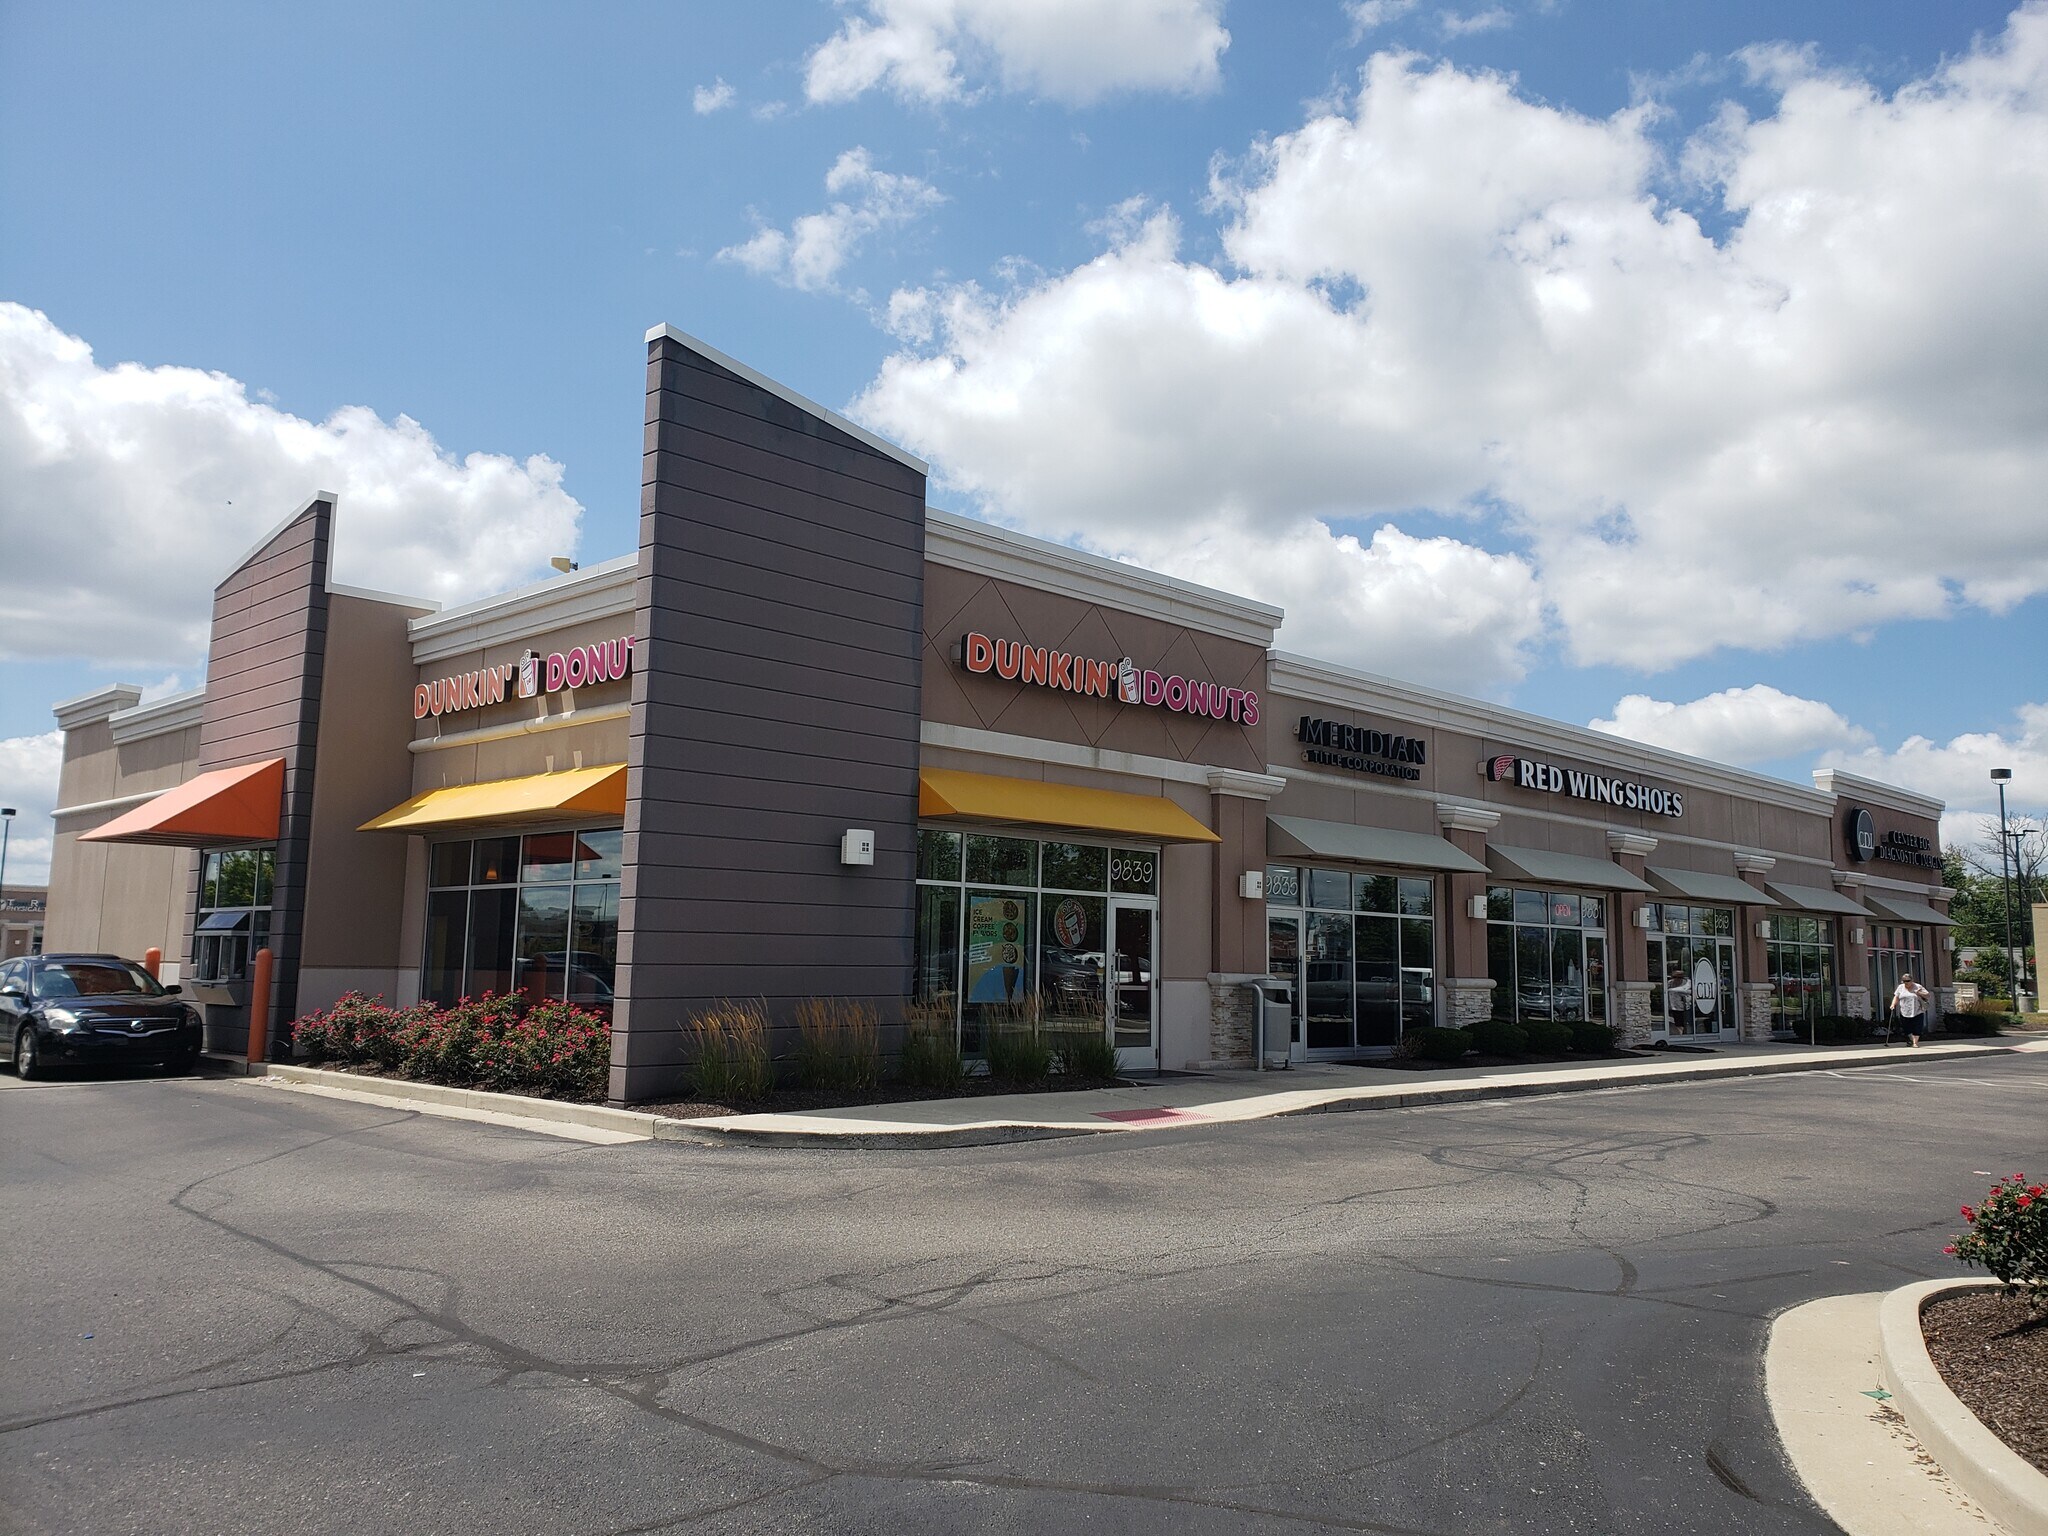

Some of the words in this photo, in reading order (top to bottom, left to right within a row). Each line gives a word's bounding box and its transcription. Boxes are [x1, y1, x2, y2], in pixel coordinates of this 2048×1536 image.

[966, 632, 1117, 698] DUNKIN'
[1143, 669, 1260, 726] DONUTS
[414, 663, 513, 719] DUNKIN'
[1304, 716, 1425, 764] MERIDIAN
[1314, 751, 1343, 766] TITLE
[1347, 757, 1420, 780] CORPORATION
[1520, 759, 1563, 793] RED
[1858, 831, 1874, 850] CDI
[1893, 831, 1918, 847] CENTER
[1880, 846, 1919, 865] DIAGNOSTIC
[1111, 859, 1153, 882] 9839
[1266, 876, 1298, 895] 9835
[973, 908, 983, 916] ICE
[1556, 904, 1571, 916] OPEN
[1697, 983, 1714, 1000] CDI
